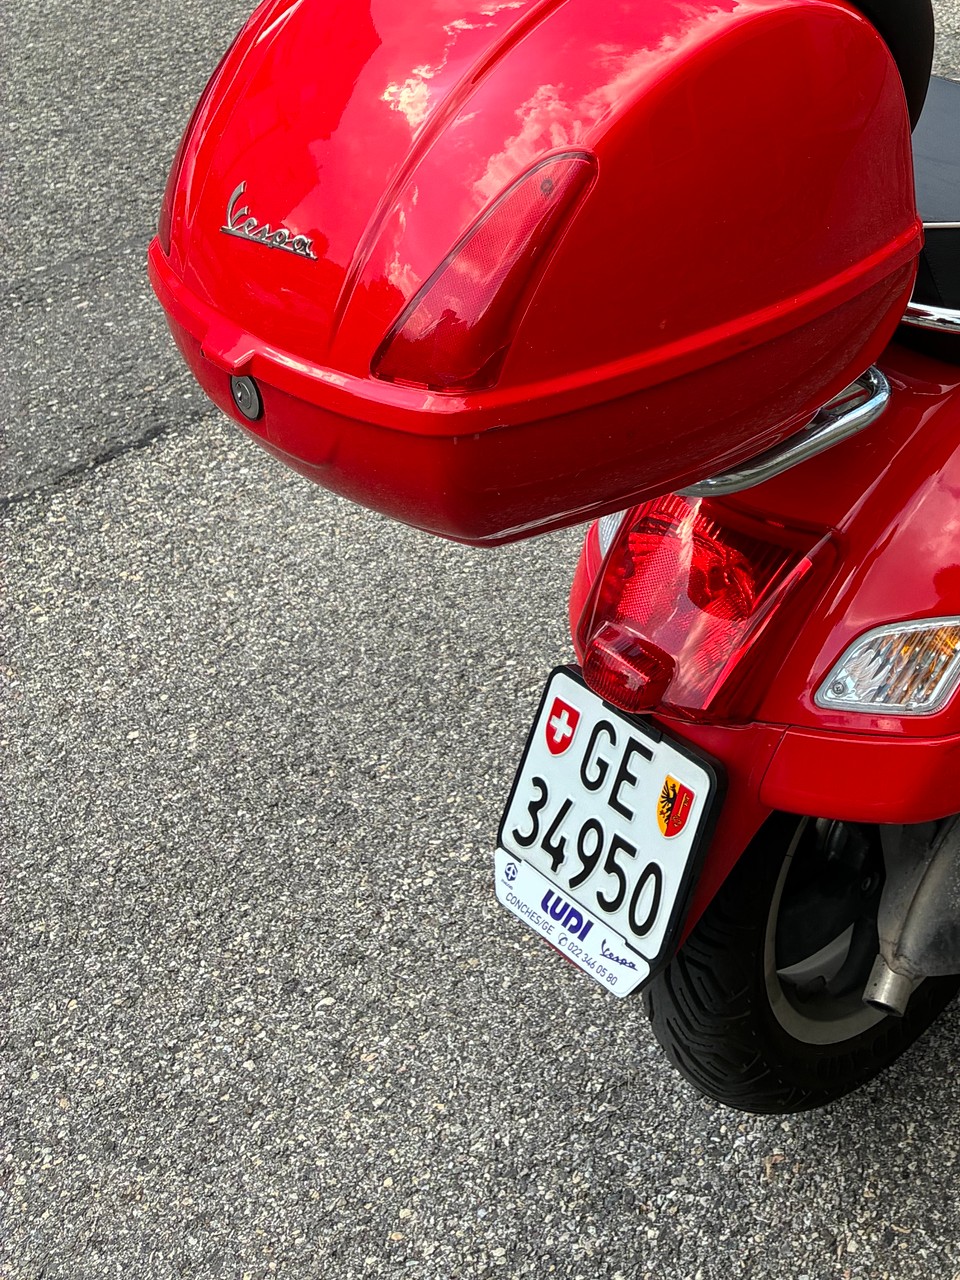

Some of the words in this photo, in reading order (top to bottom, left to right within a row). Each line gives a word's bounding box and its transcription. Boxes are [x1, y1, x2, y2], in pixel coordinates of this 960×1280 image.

[219, 180, 319, 261] Vespa
[580, 719, 655, 822] GE
[511, 775, 664, 937] 34950
[505, 891, 556, 936] CONCHES/GE
[567, 941, 583, 959] 022
[581, 953, 596, 970] 346
[595, 964, 608, 978] 05
[606, 972, 619, 986] 80
[540, 888, 595, 942] LUDI
[599, 938, 639, 972] Vespa
